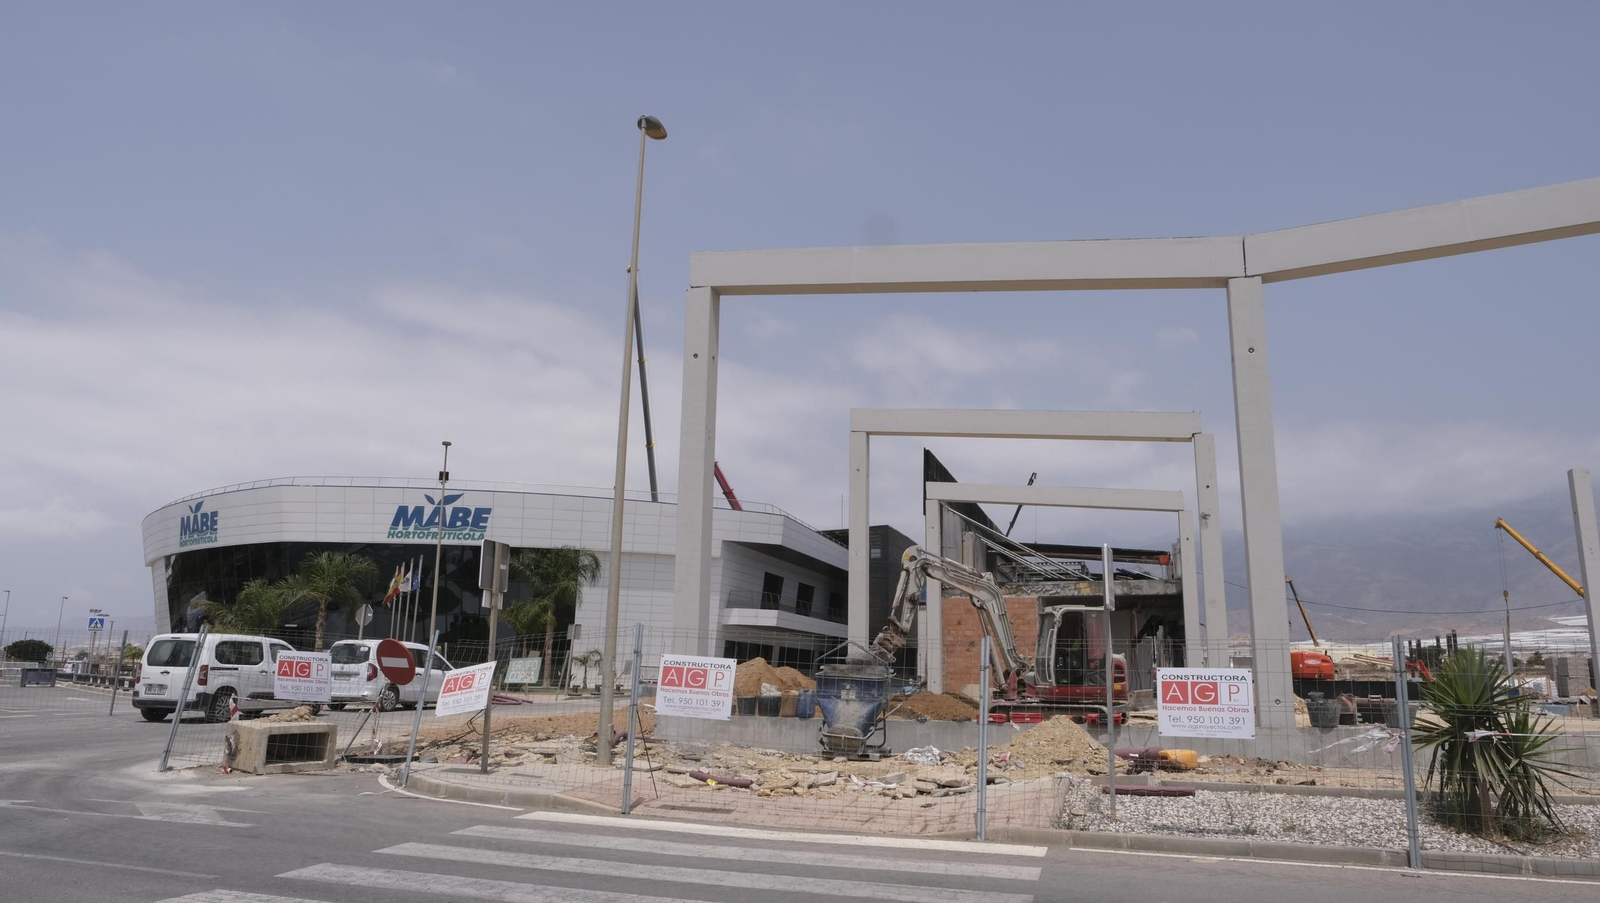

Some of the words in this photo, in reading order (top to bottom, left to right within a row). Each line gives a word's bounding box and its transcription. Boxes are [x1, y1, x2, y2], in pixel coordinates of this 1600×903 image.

[387, 531, 485, 541] HORTOFRUTICOLA
[512, 660, 538, 670] GRUPO
[664, 660, 732, 670] CONSTRUCTORA
[447, 666, 492, 678] CONSTRUCTORA
[663, 696, 676, 704] Tel.
[678, 698, 693, 706] 950
[711, 700, 724, 708] 391
[1168, 714, 1184, 723] Tel.
[1187, 716, 1205, 724] 950
[1209, 716, 1224, 724] 101
[1228, 716, 1246, 725] 391
